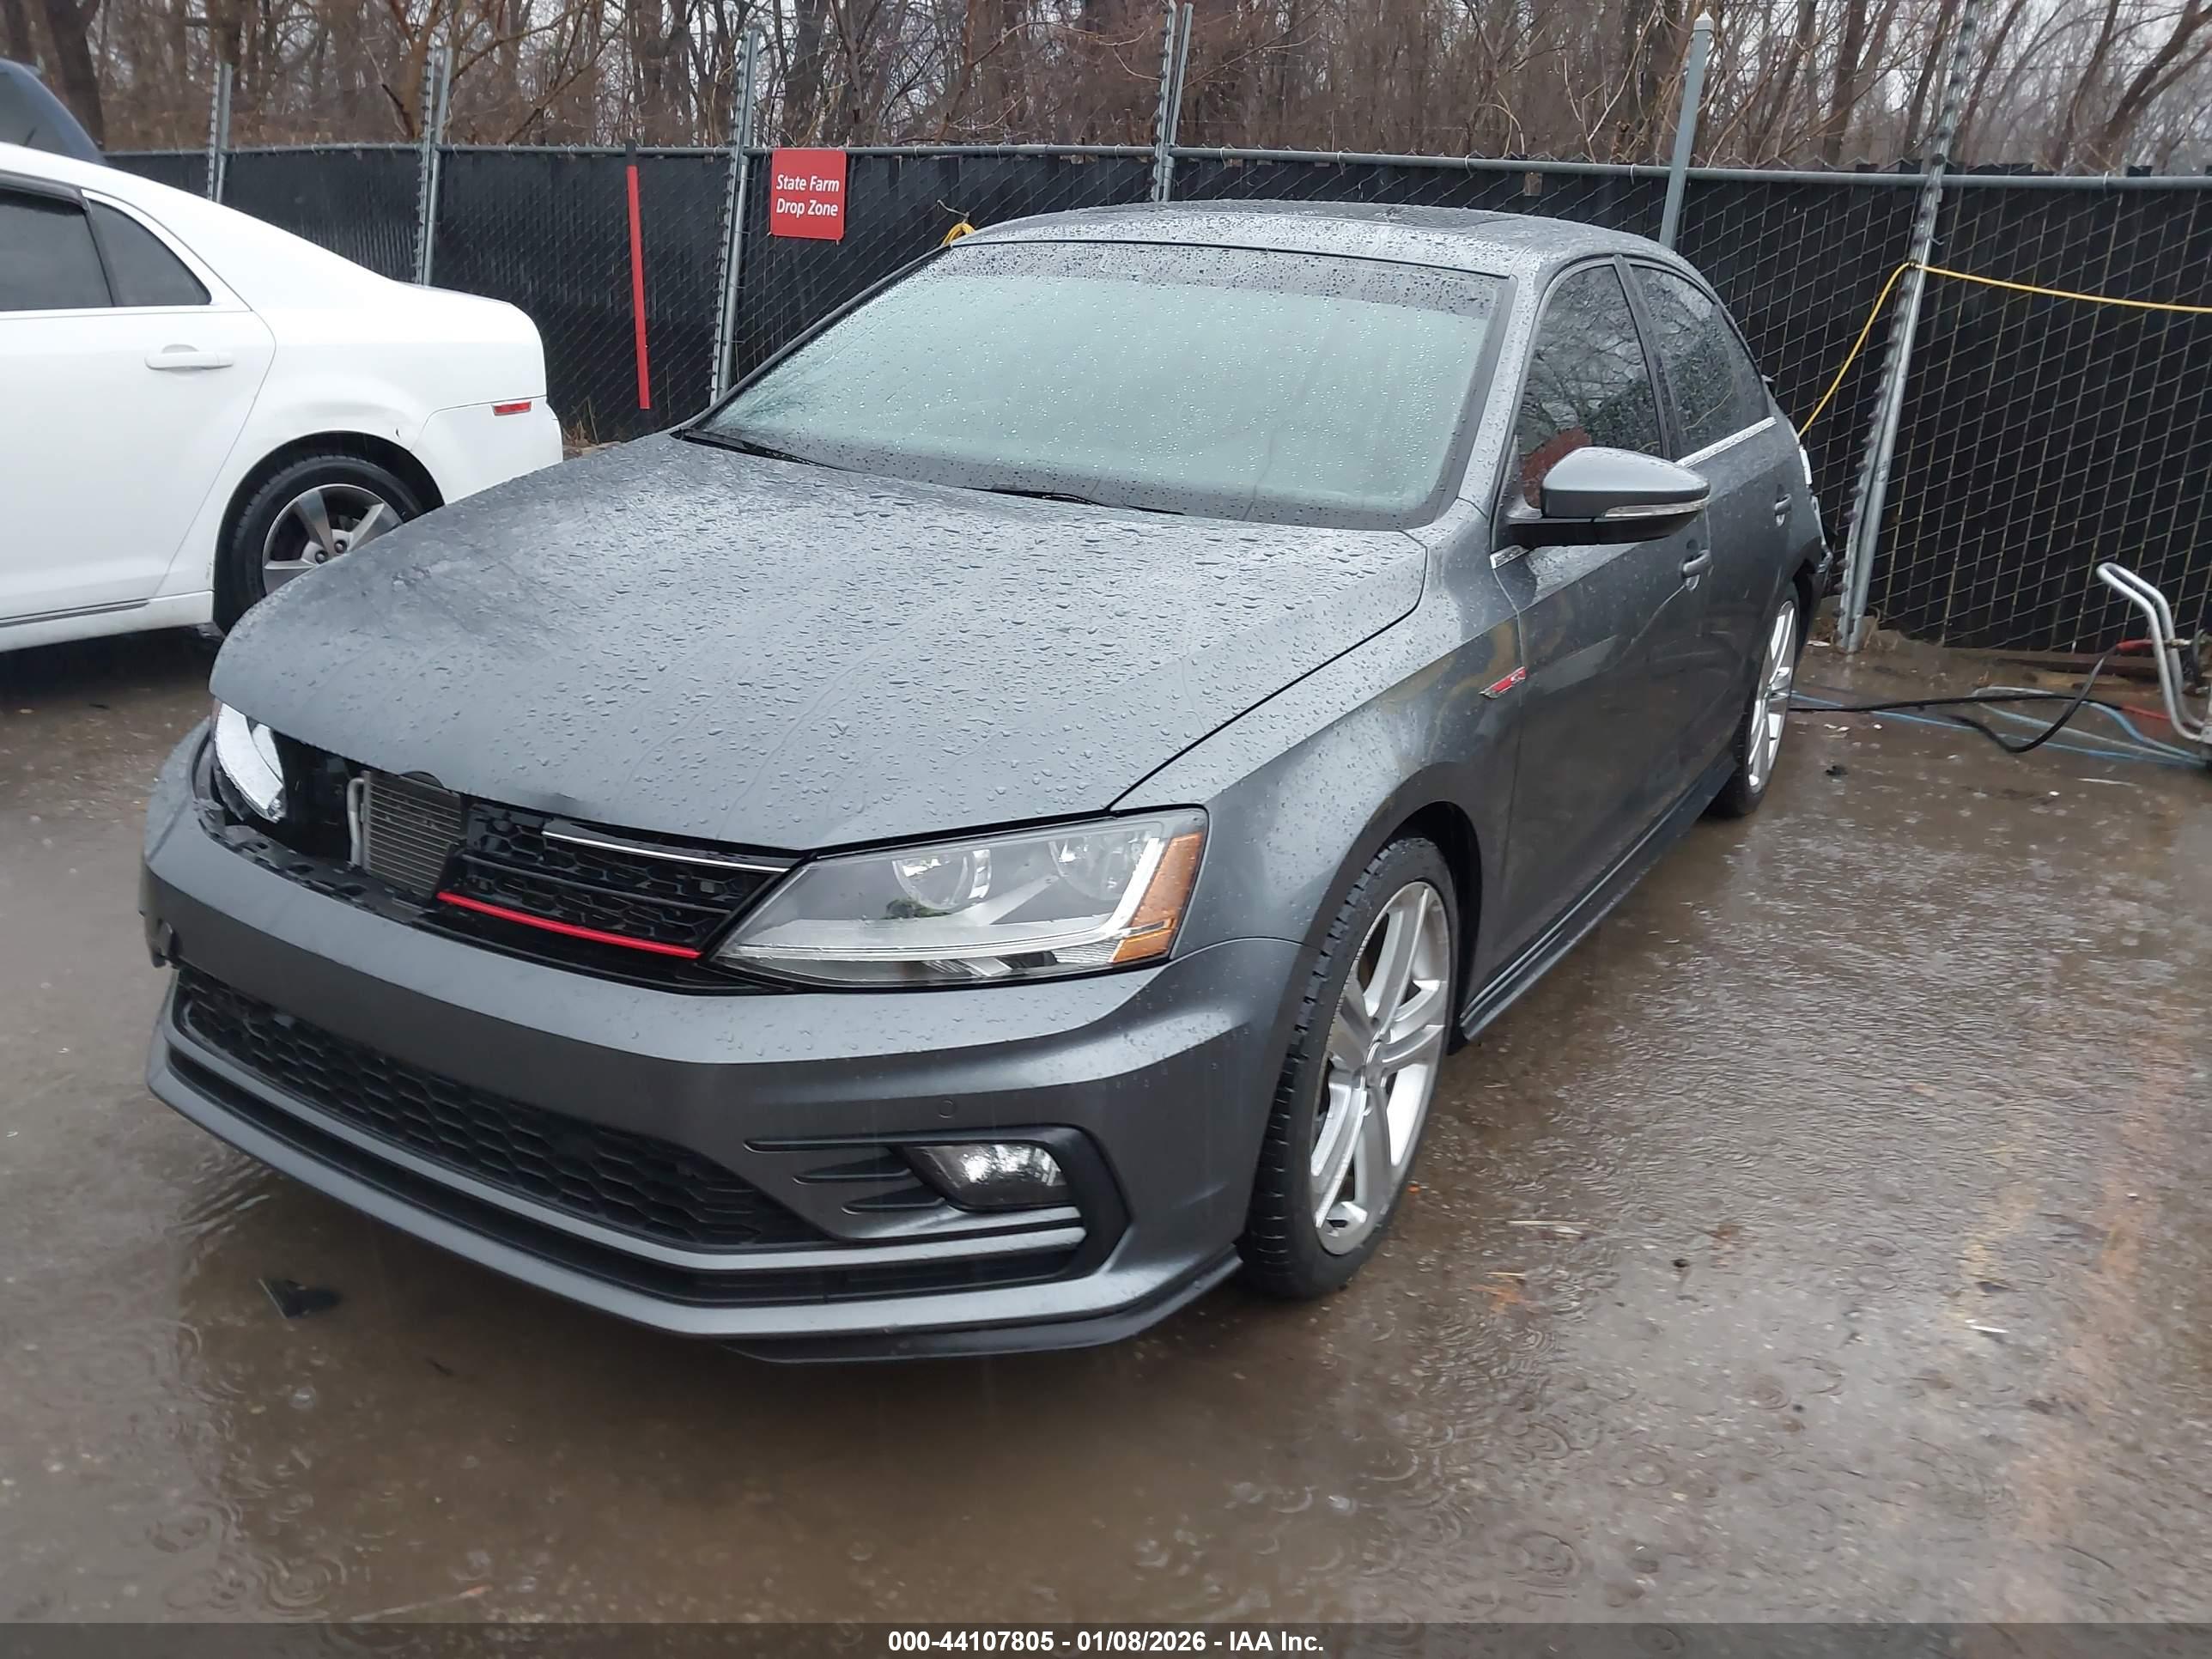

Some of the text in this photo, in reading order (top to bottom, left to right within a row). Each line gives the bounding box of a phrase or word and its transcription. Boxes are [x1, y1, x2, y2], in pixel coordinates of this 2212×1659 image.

[776, 174, 840, 192] State Farm
[776, 198, 838, 218] Drop Zone
